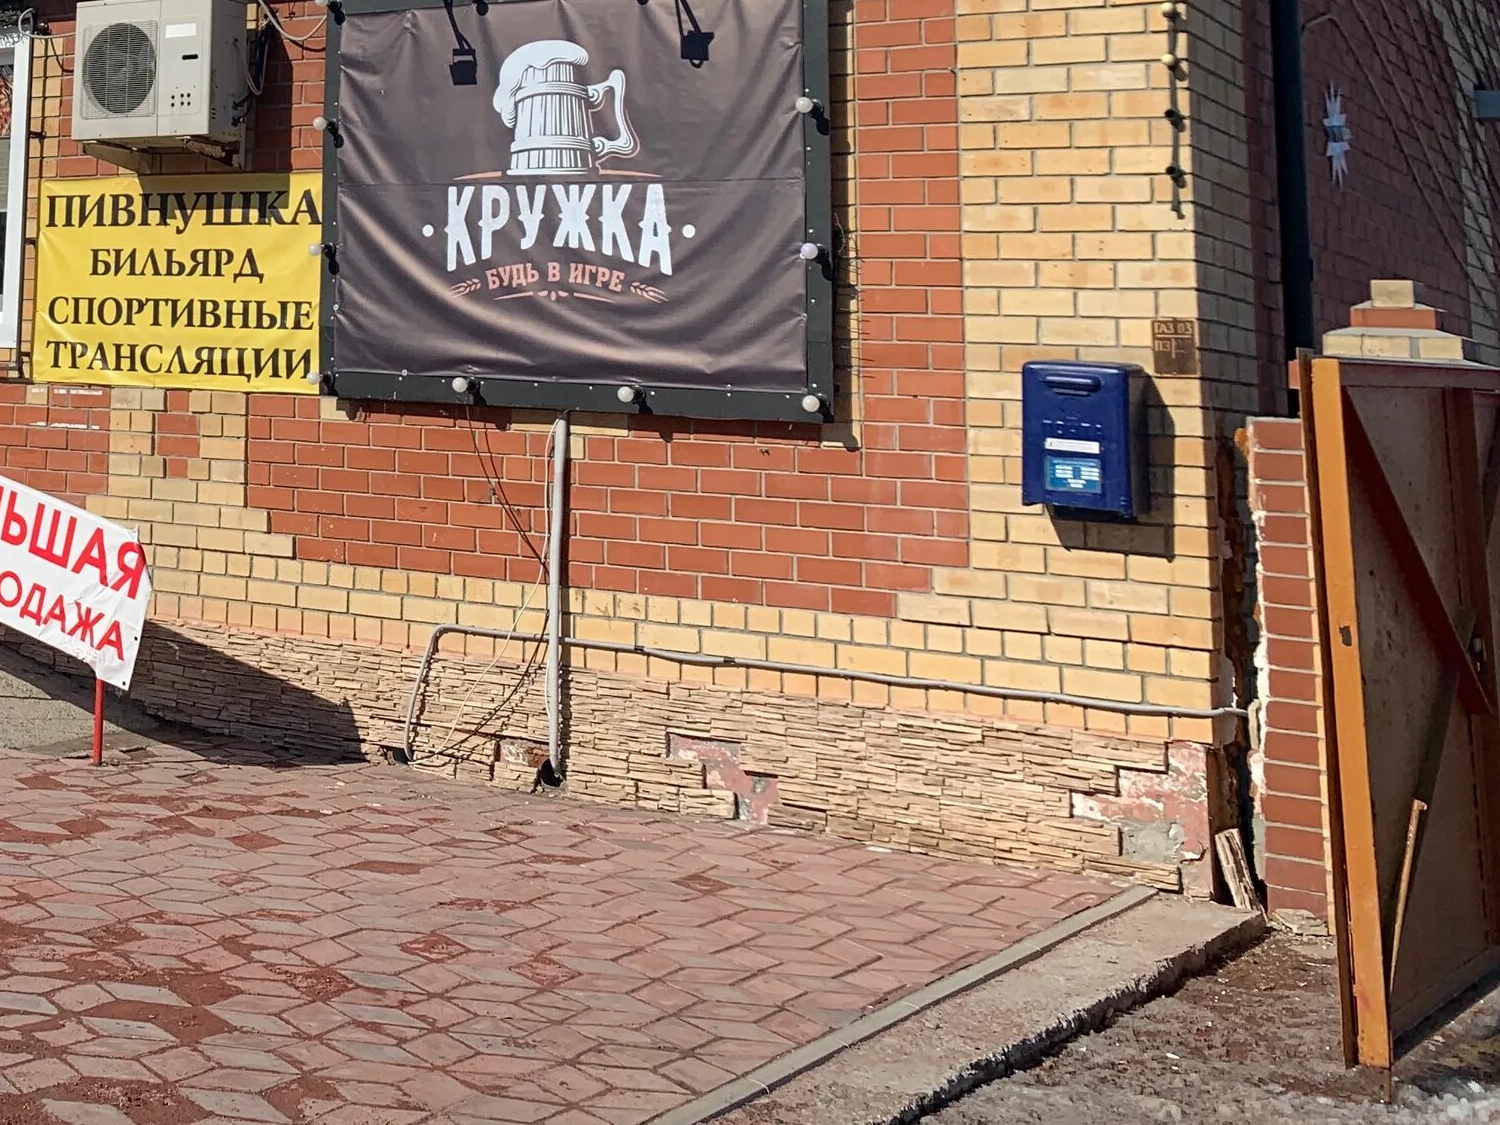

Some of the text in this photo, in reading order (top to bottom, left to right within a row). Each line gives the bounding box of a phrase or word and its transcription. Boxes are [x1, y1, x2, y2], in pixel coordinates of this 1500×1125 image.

[45, 188, 322, 235] ПИВНУШКА
[447, 184, 673, 276] КРУЖКА
[89, 247, 265, 284] БИЛЬЯРД
[485, 263, 626, 292] БУДЬ В ИГРЕ
[48, 295, 314, 331] СПОРТИВНЫЕ
[46, 339, 313, 383] ТРАНСЛЯЦИИ
